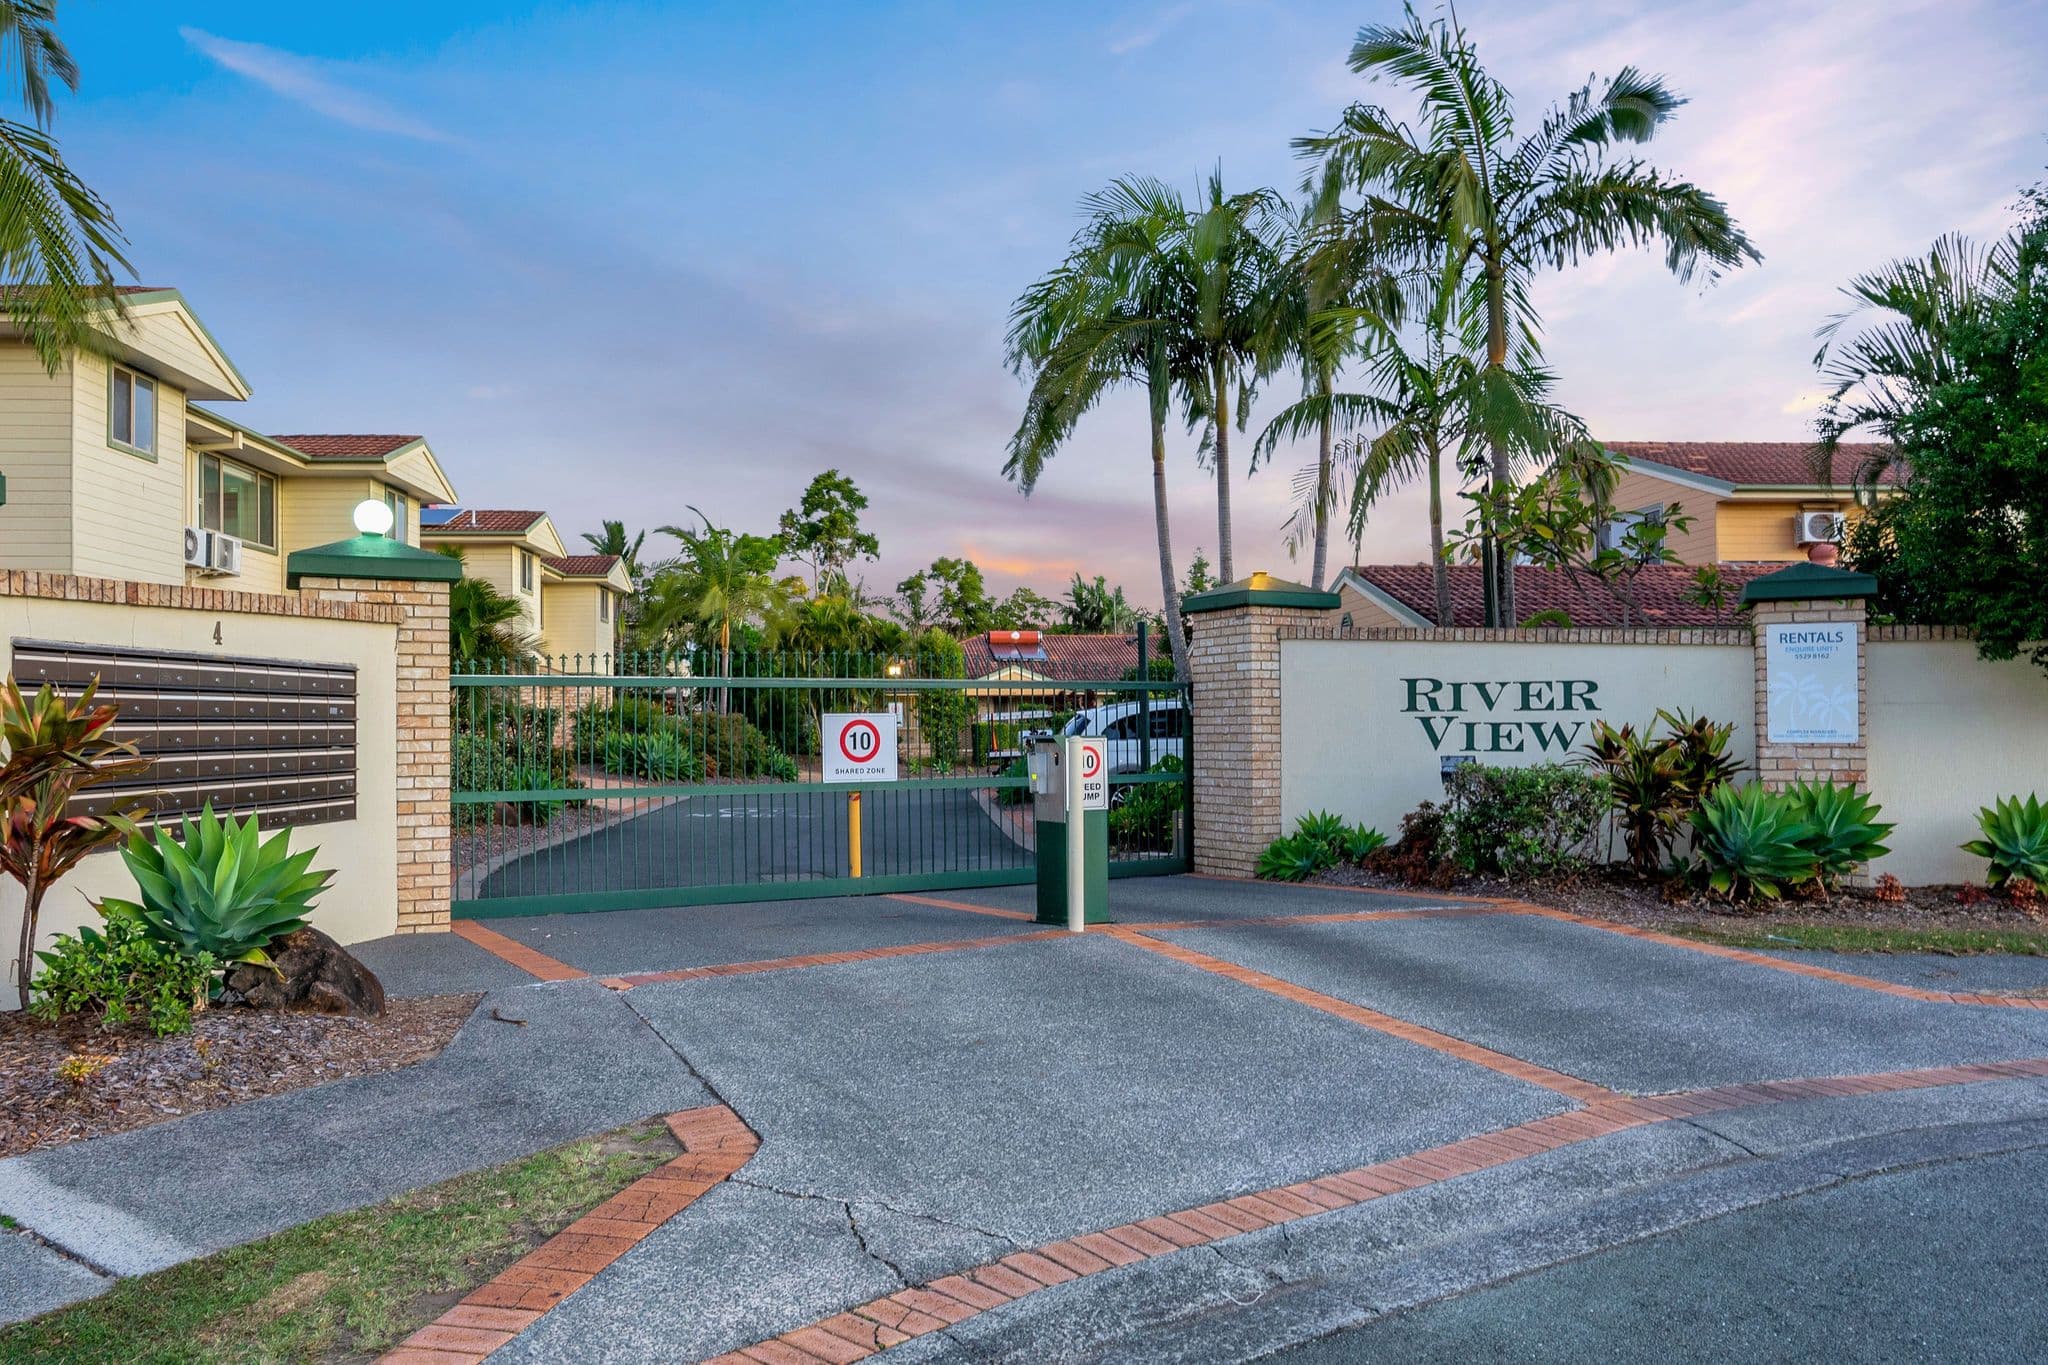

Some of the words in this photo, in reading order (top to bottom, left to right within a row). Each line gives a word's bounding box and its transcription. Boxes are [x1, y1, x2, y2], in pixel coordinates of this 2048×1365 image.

[212, 620, 223, 645] 4
[1779, 631, 1844, 643] RENTALS
[1399, 677, 1603, 712] RIVER
[849, 731, 871, 750] 10
[1414, 715, 1586, 753] VIEW
[1084, 782, 1101, 791] EED
[1083, 792, 1100, 801] UMP
